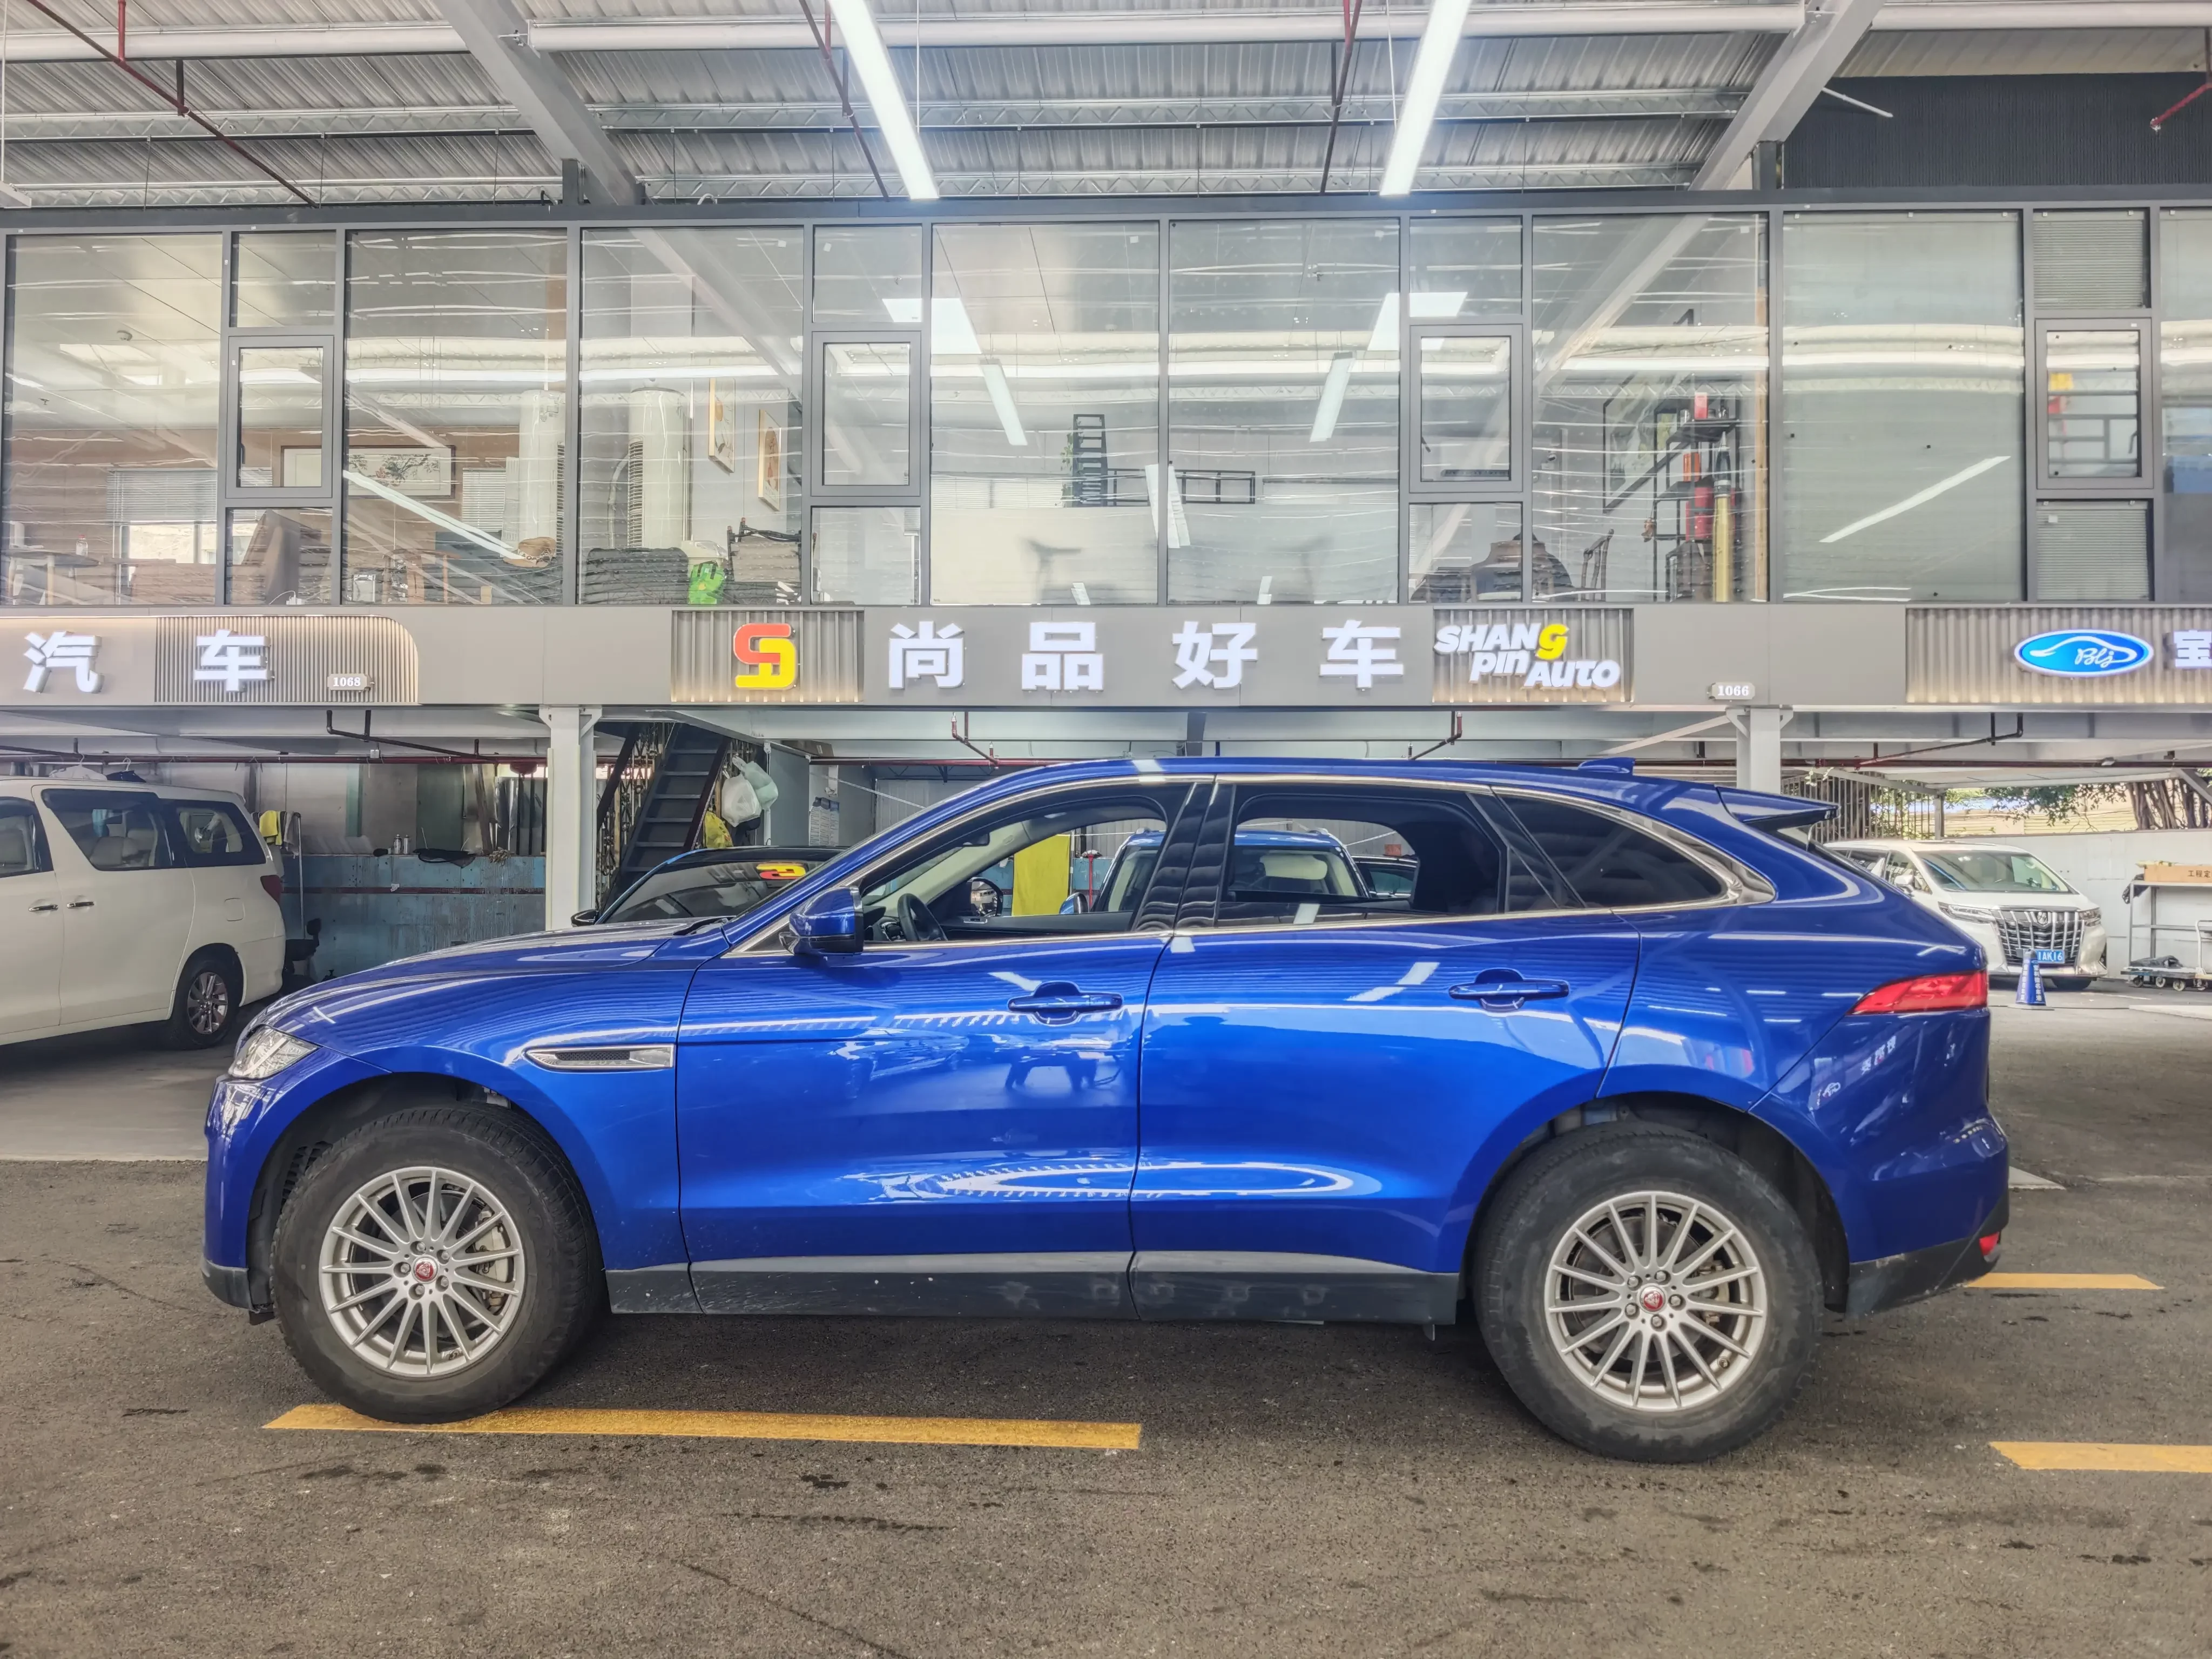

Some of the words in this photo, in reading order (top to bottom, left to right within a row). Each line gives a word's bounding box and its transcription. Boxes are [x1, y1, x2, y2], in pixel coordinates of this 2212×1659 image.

[24, 630, 268, 692] 汽车
[888, 620, 1404, 691] 尚品好车
[333, 677, 361, 687] 1068
[1525, 659, 1621, 688] AUTO
[1717, 686, 1749, 696] 1066
